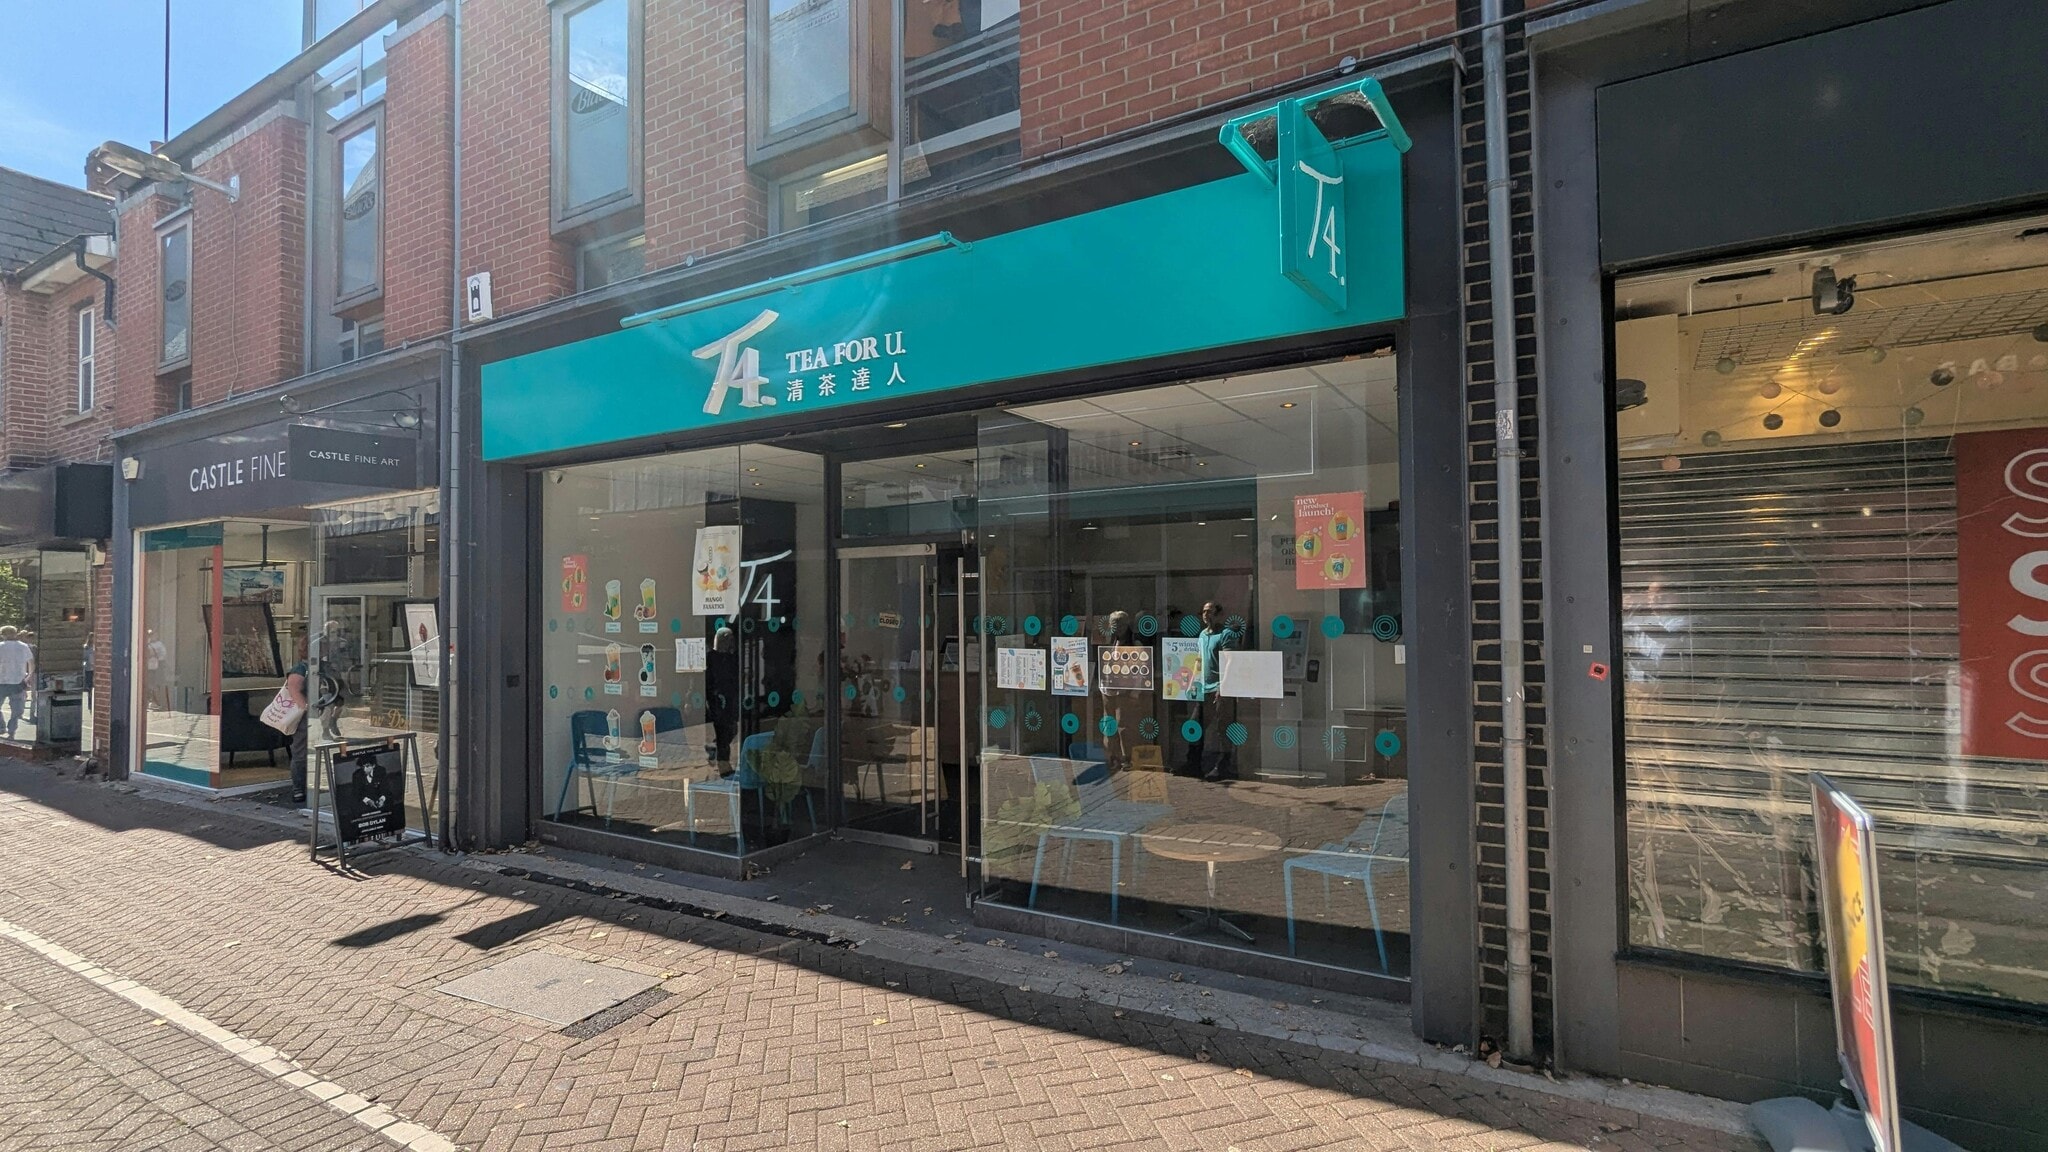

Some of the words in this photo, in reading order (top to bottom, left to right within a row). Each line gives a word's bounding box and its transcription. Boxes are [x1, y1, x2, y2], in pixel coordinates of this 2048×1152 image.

[785, 347, 829, 374] TEA
[833, 336, 880, 365] FOR
[786, 362, 906, 402] 清茶達人
[308, 450, 351, 462] CASTLE
[354, 454, 377, 465] FINE
[380, 458, 400, 467] ART
[189, 459, 244, 493] CASTLE
[250, 450, 287, 482] FINE
[1296, 497, 1317, 505] new
[1303, 502, 1329, 510] product
[1298, 507, 1335, 517] launch!
[1171, 641, 1178, 652] 5
